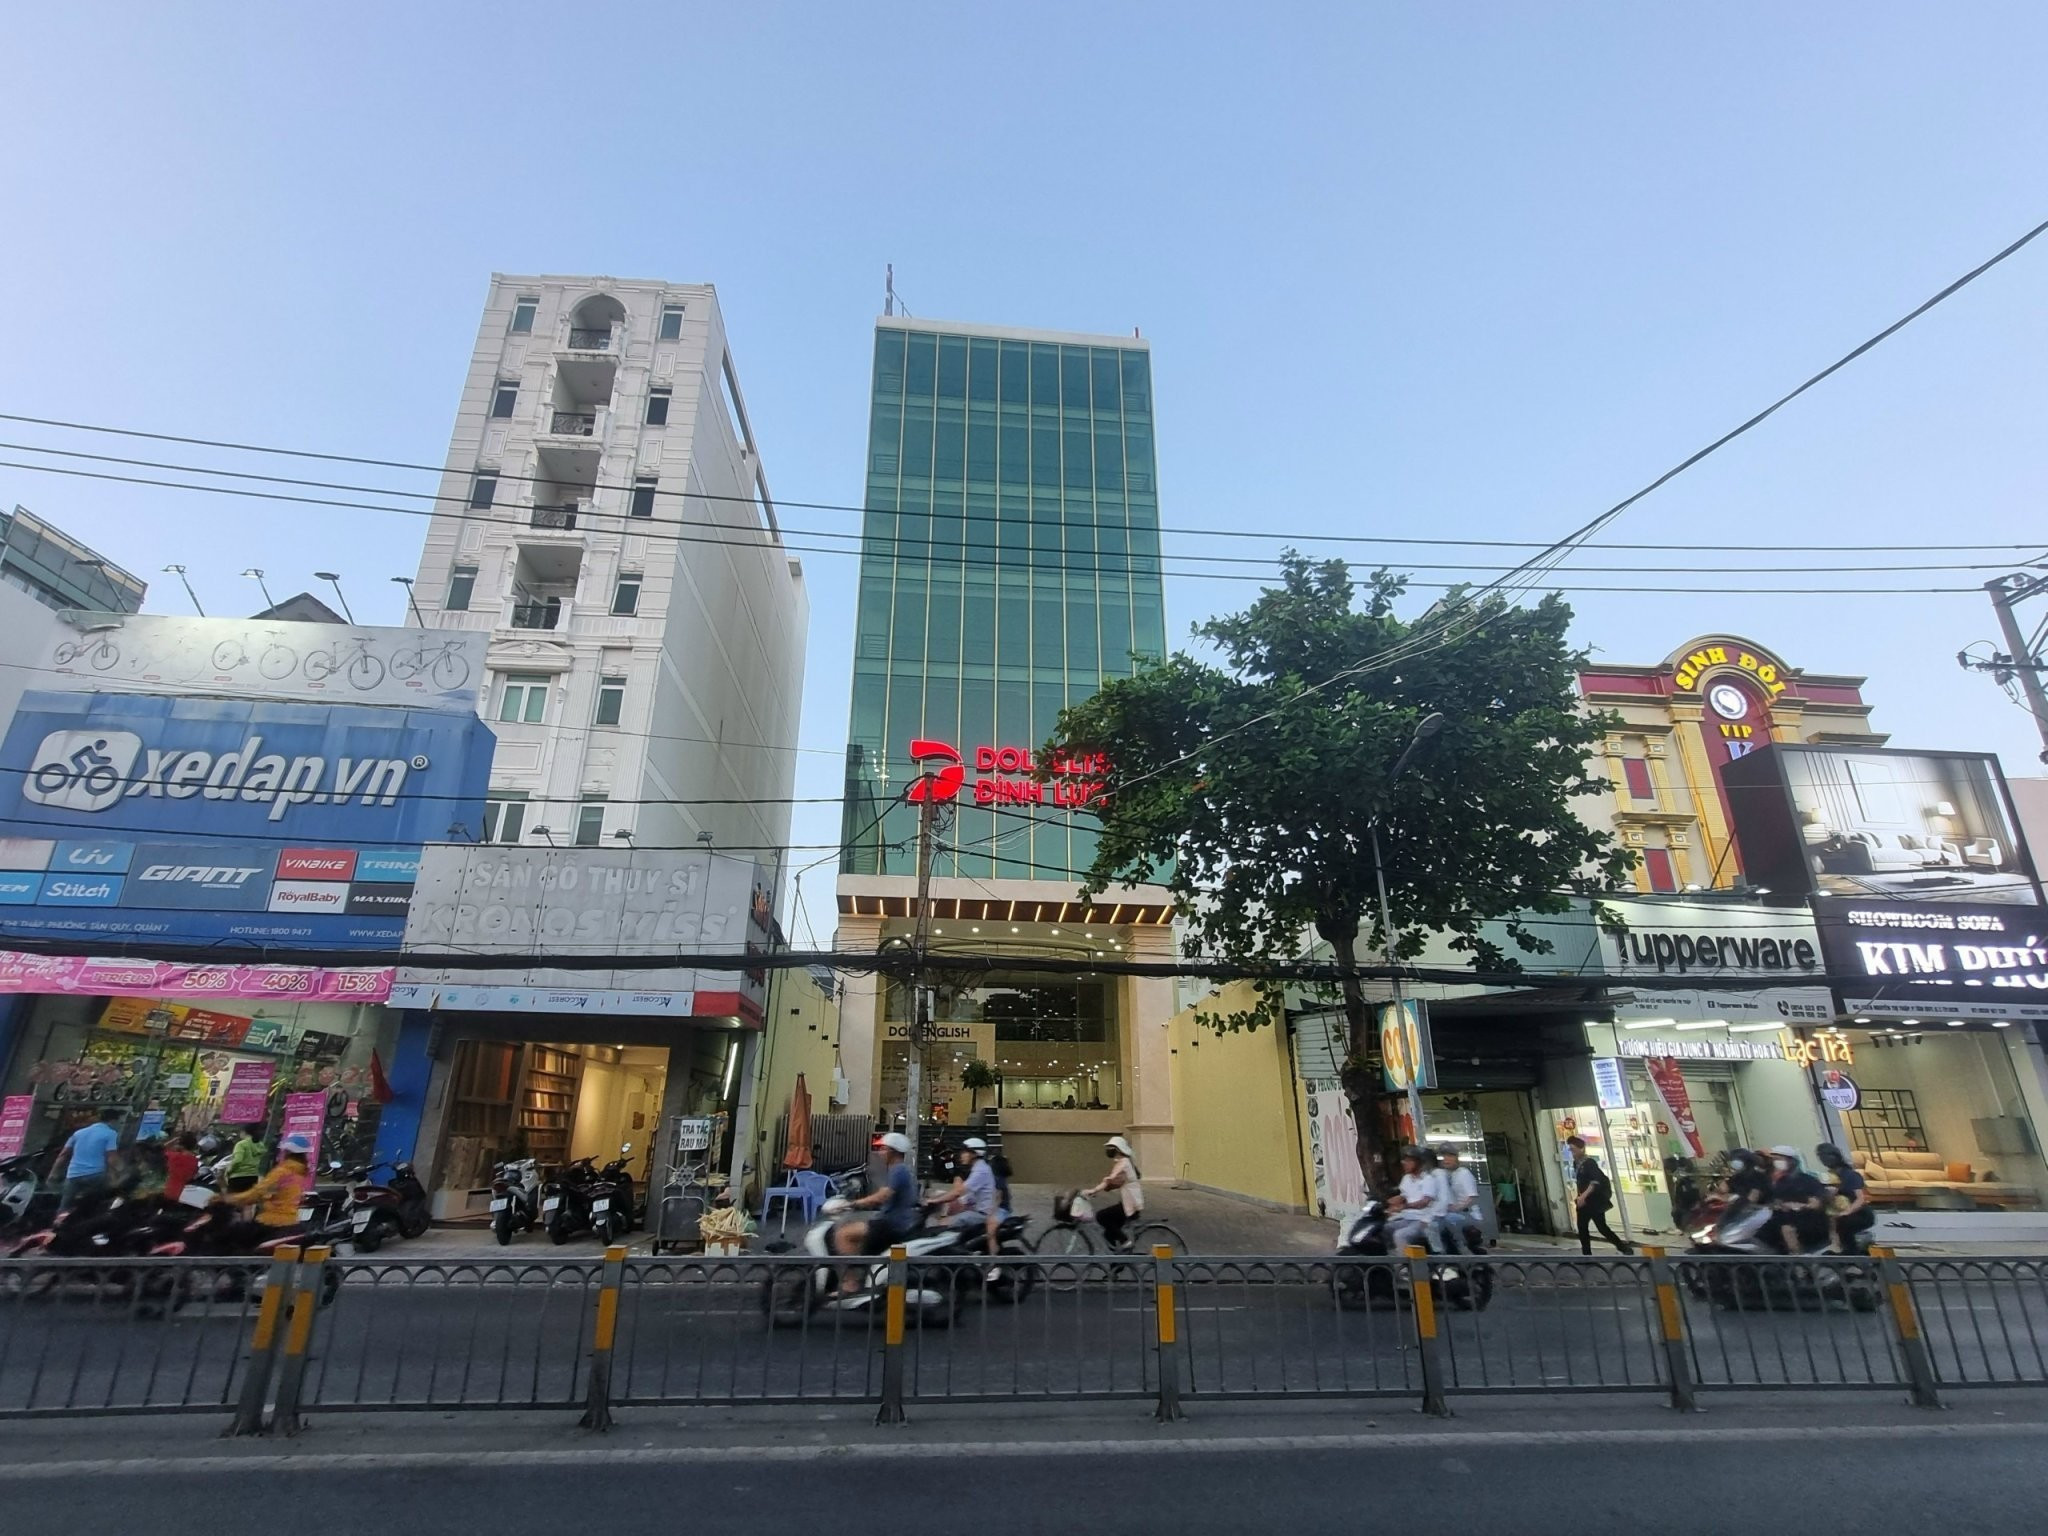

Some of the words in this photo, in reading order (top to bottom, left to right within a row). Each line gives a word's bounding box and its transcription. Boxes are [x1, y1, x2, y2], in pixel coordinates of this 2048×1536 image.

[1675, 648, 1728, 690] SINH
[1738, 652, 1786, 693] ĐÔI
[1720, 724, 1752, 738] VIP
[976, 746, 1037, 771] DOL
[126, 737, 408, 822] xedap.vn
[69, 848, 114, 865] Liv
[286, 859, 347, 870] VINBIKE
[138, 864, 264, 883] GIANT
[0, 884, 30, 892] EM
[46, 882, 111, 897] Stitch
[277, 890, 341, 905] RoyalBaby
[353, 895, 411, 904] MAXBIK
[1848, 910, 1955, 930] SHOWROOM
[1957, 915, 2005, 931] SOFA
[1607, 930, 1816, 974] Tupperware
[182, 971, 228, 989] 50%
[261, 973, 308, 991] 40%
[338, 974, 377, 991] 15%
[921, 1026, 970, 1038] ENGLISH
[1778, 1031, 1818, 1068] Lạc
[1812, 1033, 1853, 1065] Trà
